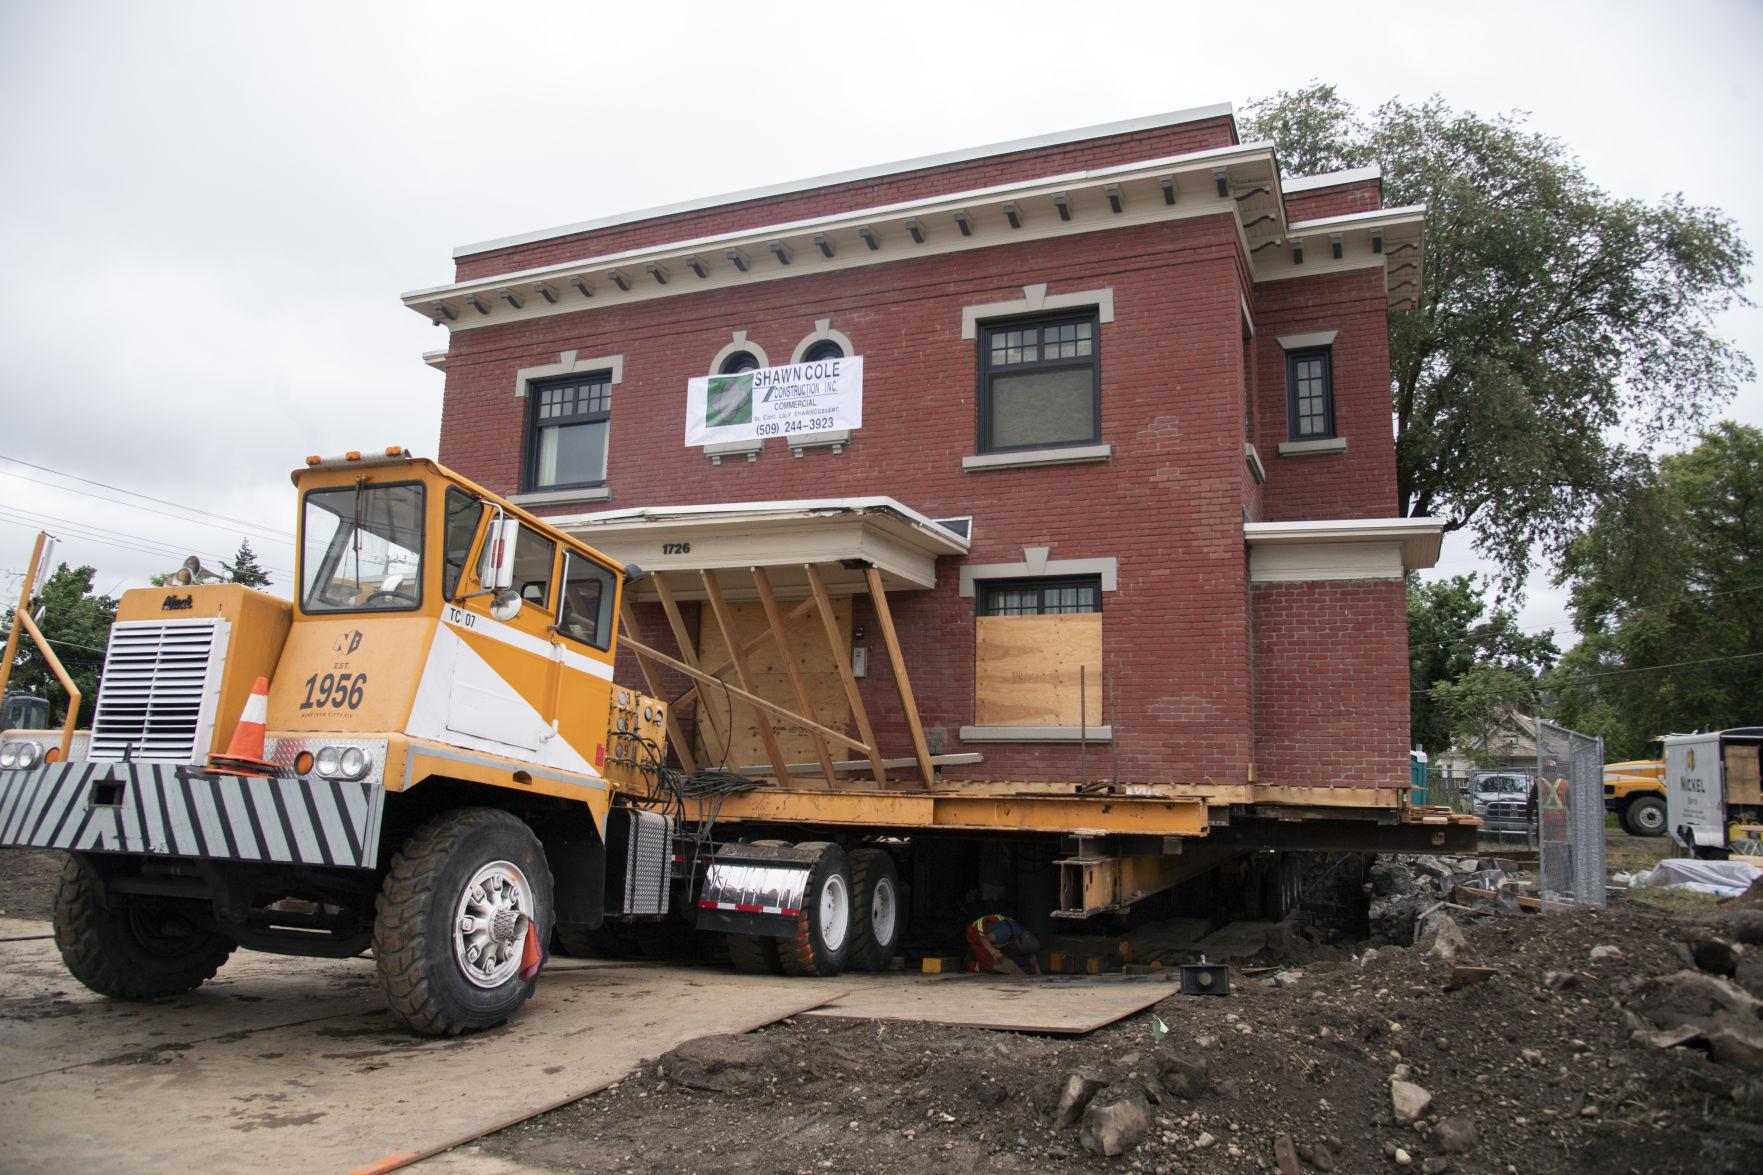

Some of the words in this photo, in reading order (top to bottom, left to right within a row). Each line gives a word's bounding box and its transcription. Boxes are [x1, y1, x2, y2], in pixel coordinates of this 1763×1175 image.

[754, 367, 801, 387] SHAWN
[805, 362, 840, 380] COLE
[774, 383, 819, 399] CONSTRUCTION
[824, 381, 838, 392] INC.
[774, 398, 816, 411] COMMERCIAL
[756, 422, 780, 437] (509)
[784, 416, 834, 433] 244-3923
[662, 543, 690, 555] 1726
[450, 607, 461, 623] TC
[465, 613, 476, 628] 07
[299, 673, 367, 711] 1956
[1680, 776, 1706, 793] NICKEL
